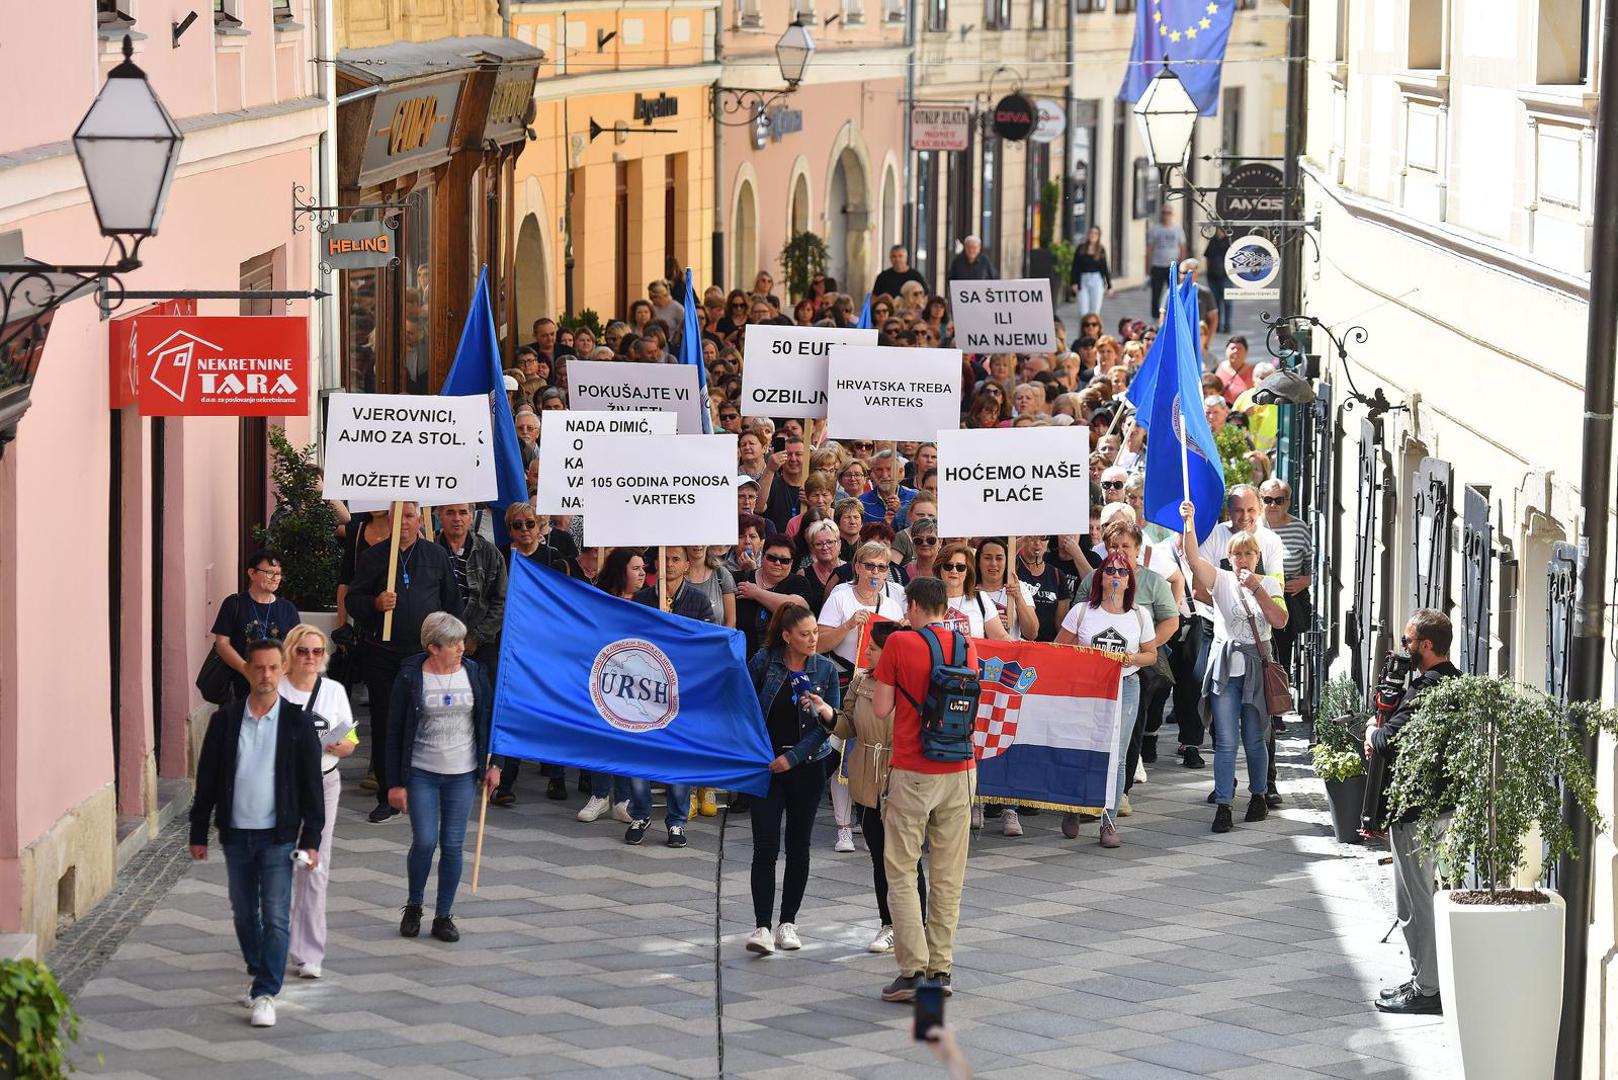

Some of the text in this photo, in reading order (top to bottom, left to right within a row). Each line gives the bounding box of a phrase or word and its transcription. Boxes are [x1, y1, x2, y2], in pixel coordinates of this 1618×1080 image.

[997, 111, 1030, 123] DIVA
[329, 234, 390, 256] HELINO
[960, 288, 1043, 303] SA ŠTITOM
[994, 312, 1012, 324] ILI
[967, 333, 1047, 346] NA NJEMU
[772, 341, 792, 354] 50
[197, 358, 292, 370] NEKRETNINE
[197, 373, 298, 394] TARA
[836, 379, 952, 394] HRVATSKA TREBA
[578, 384, 671, 400] POKUŠAJTE
[675, 388, 689, 400] VI
[864, 396, 923, 408] VARTEKS
[353, 407, 456, 425] VJEROVNICI,
[565, 418, 652, 435] NADA DIMIĆ,
[338, 430, 387, 443] AJMO
[391, 431, 413, 444] ZA
[418, 432, 466, 446] STOL.
[945, 461, 1081, 481] HOĆEMO NAŠE
[341, 472, 457, 489] MOŽETE VI TO
[591, 475, 730, 488] 105 GODINA PONOSA
[633, 494, 696, 505] VARTEKS
[983, 484, 1043, 502] PLAĆE
[601, 673, 669, 704] URSH
